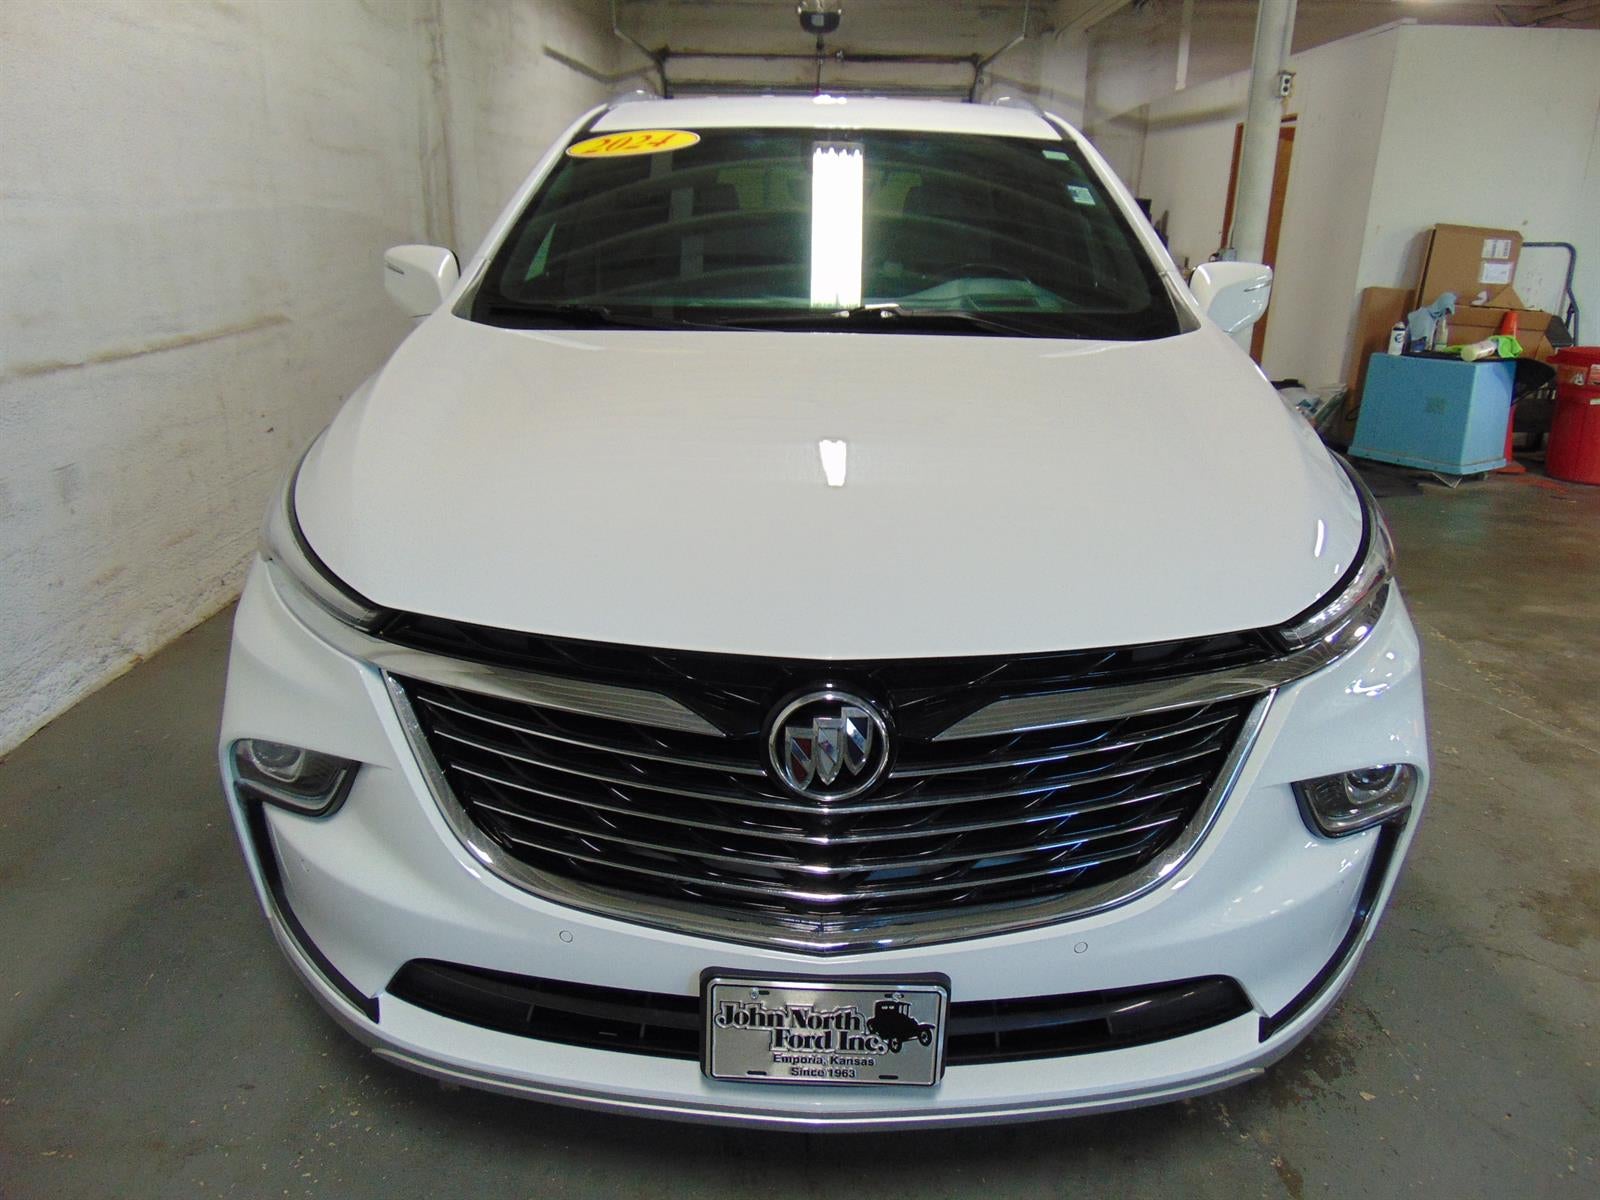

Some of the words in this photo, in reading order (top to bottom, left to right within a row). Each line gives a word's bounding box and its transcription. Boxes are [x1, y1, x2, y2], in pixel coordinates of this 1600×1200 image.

[581, 133, 677, 154] 2024
[716, 1001, 785, 1029] John
[789, 1004, 862, 1031] North
[773, 1029, 832, 1051] Ford
[838, 1031, 888, 1053] Inc.
[773, 1054, 827, 1066] Emporia,
[830, 1056, 875, 1067] Kansas
[791, 1067, 825, 1078] Since
[828, 1068, 856, 1079] 1963
